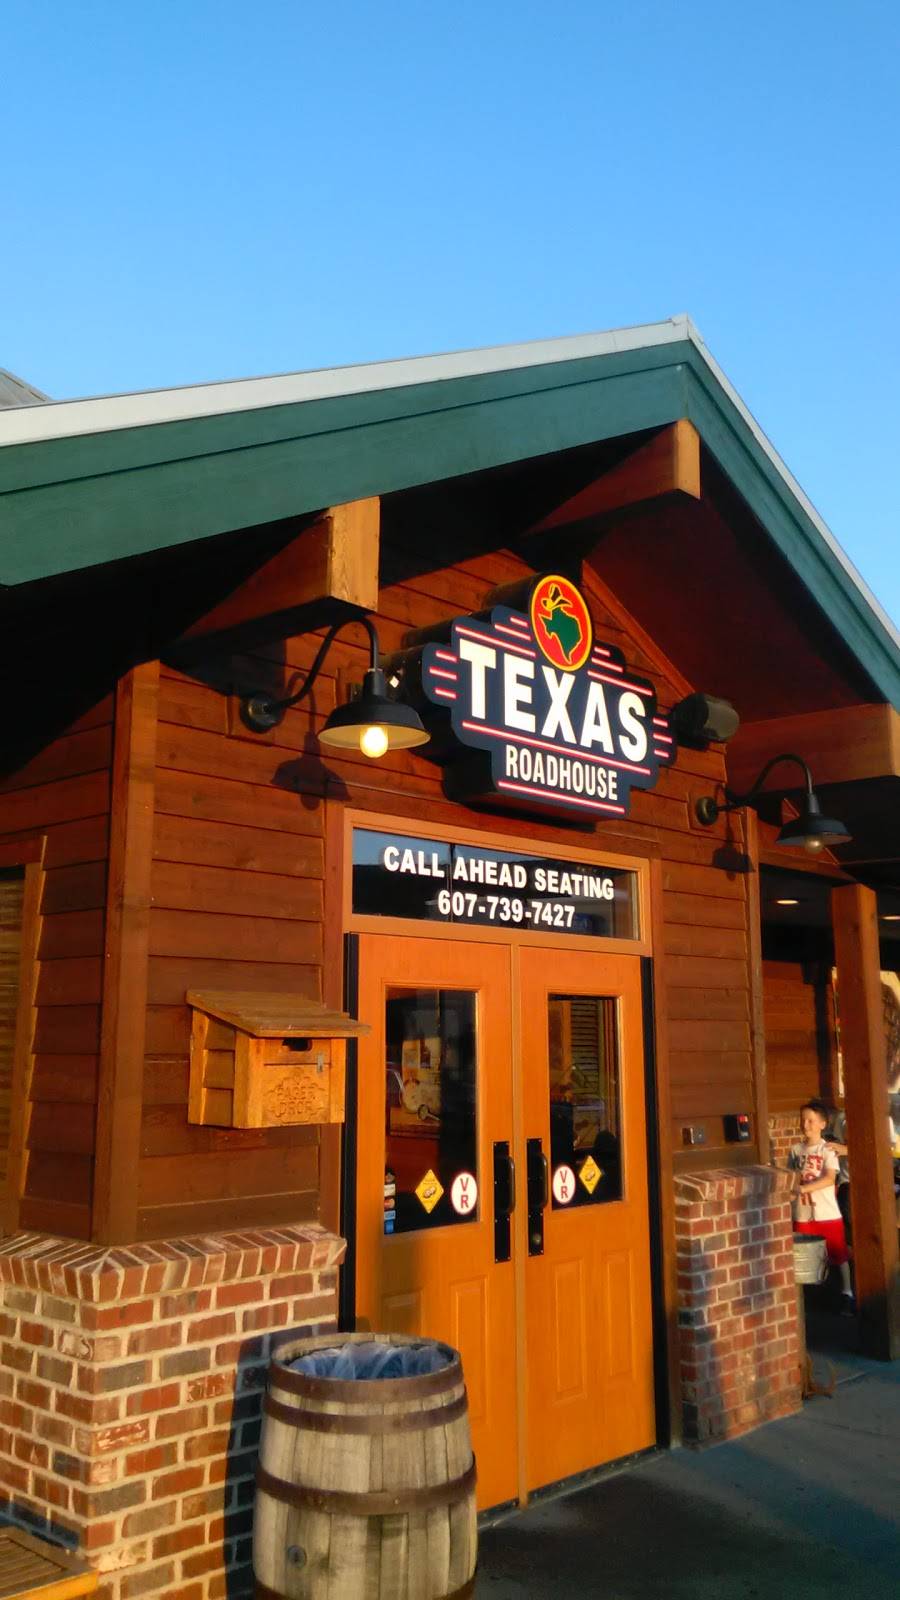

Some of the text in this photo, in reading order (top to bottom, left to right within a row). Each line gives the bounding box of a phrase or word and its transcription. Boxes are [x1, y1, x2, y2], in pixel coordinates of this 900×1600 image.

[459, 638, 648, 762] TEXAS
[505, 744, 618, 801] ROADHOUSE
[383, 846, 615, 901] CALL AHEAD SEATING
[437, 890, 576, 928] 607-739-7427
[279, 1101, 313, 1115] DROP
[460, 1177, 469, 1192] V
[559, 1170, 568, 1184] V
[559, 1185, 569, 1199] R
[460, 1195, 469, 1209] R
